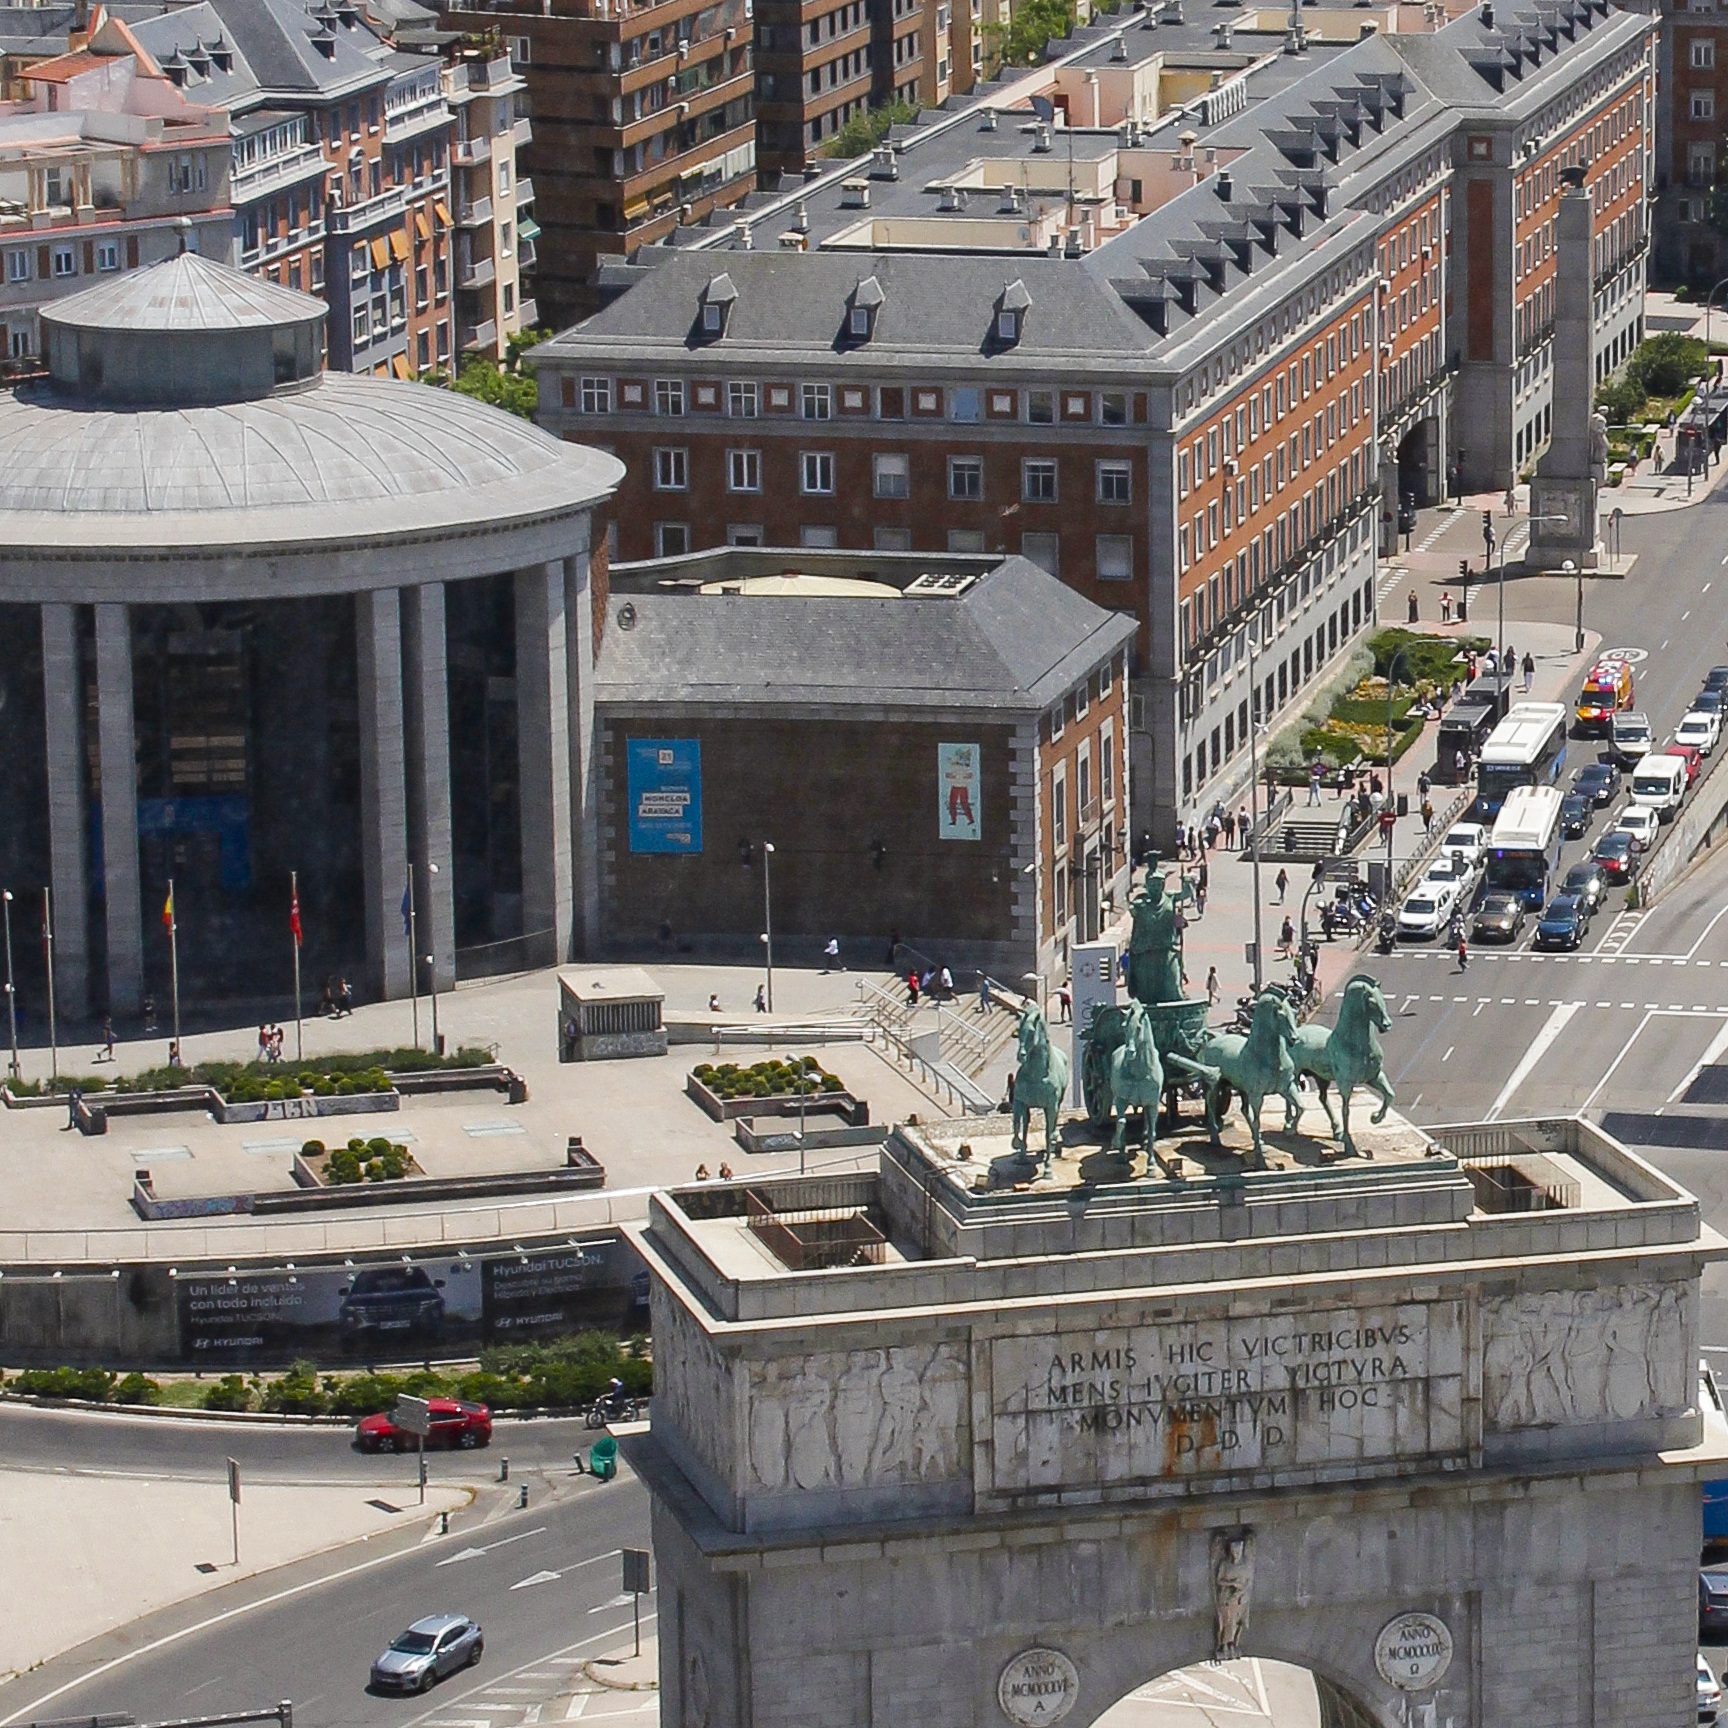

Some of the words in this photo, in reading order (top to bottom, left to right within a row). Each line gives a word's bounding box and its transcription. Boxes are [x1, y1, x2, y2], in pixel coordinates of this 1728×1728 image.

[493, 1259, 546, 1276] Hyundai
[189, 1285, 208, 1296] Un
[242, 1282, 258, 1294] de
[261, 1281, 306, 1293] ventas
[190, 1301, 215, 1310] con
[217, 1297, 248, 1309] todo
[515, 1312, 564, 1325] HYUNDAI
[213, 1337, 264, 1347] HYUNDAI
[1049, 1347, 1138, 1374] ARMIS
[1168, 1341, 1213, 1365] HIC
[1241, 1325, 1411, 1360] VICTRICIBVS
[1048, 1378, 1122, 1406] MENS
[1145, 1369, 1252, 1398] IVGITER
[1284, 1354, 1410, 1389] VICTVRA
[1078, 1395, 1289, 1434] MONVMENTVM
[1319, 1387, 1379, 1412] HOC
[1399, 1626, 1431, 1642] ANNO
[1024, 1665, 1056, 1678] ANNO
[1033, 1700, 1046, 1713] A
